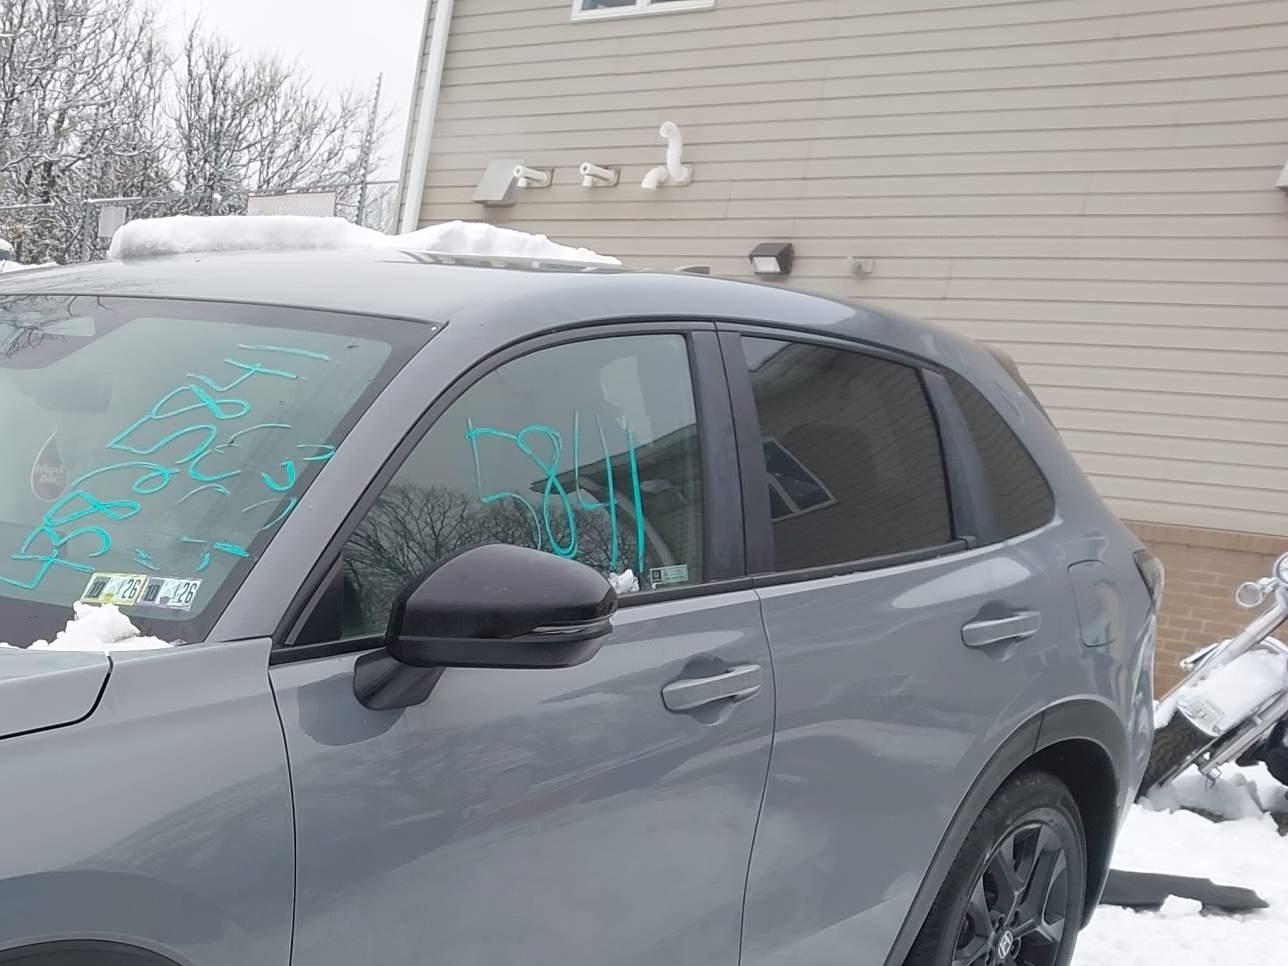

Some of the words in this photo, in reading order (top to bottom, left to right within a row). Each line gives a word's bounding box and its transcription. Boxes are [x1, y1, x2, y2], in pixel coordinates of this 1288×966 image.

[465, 409, 646, 574] 5841
[121, 579, 141, 599] 26
[178, 582, 197, 603] 26
